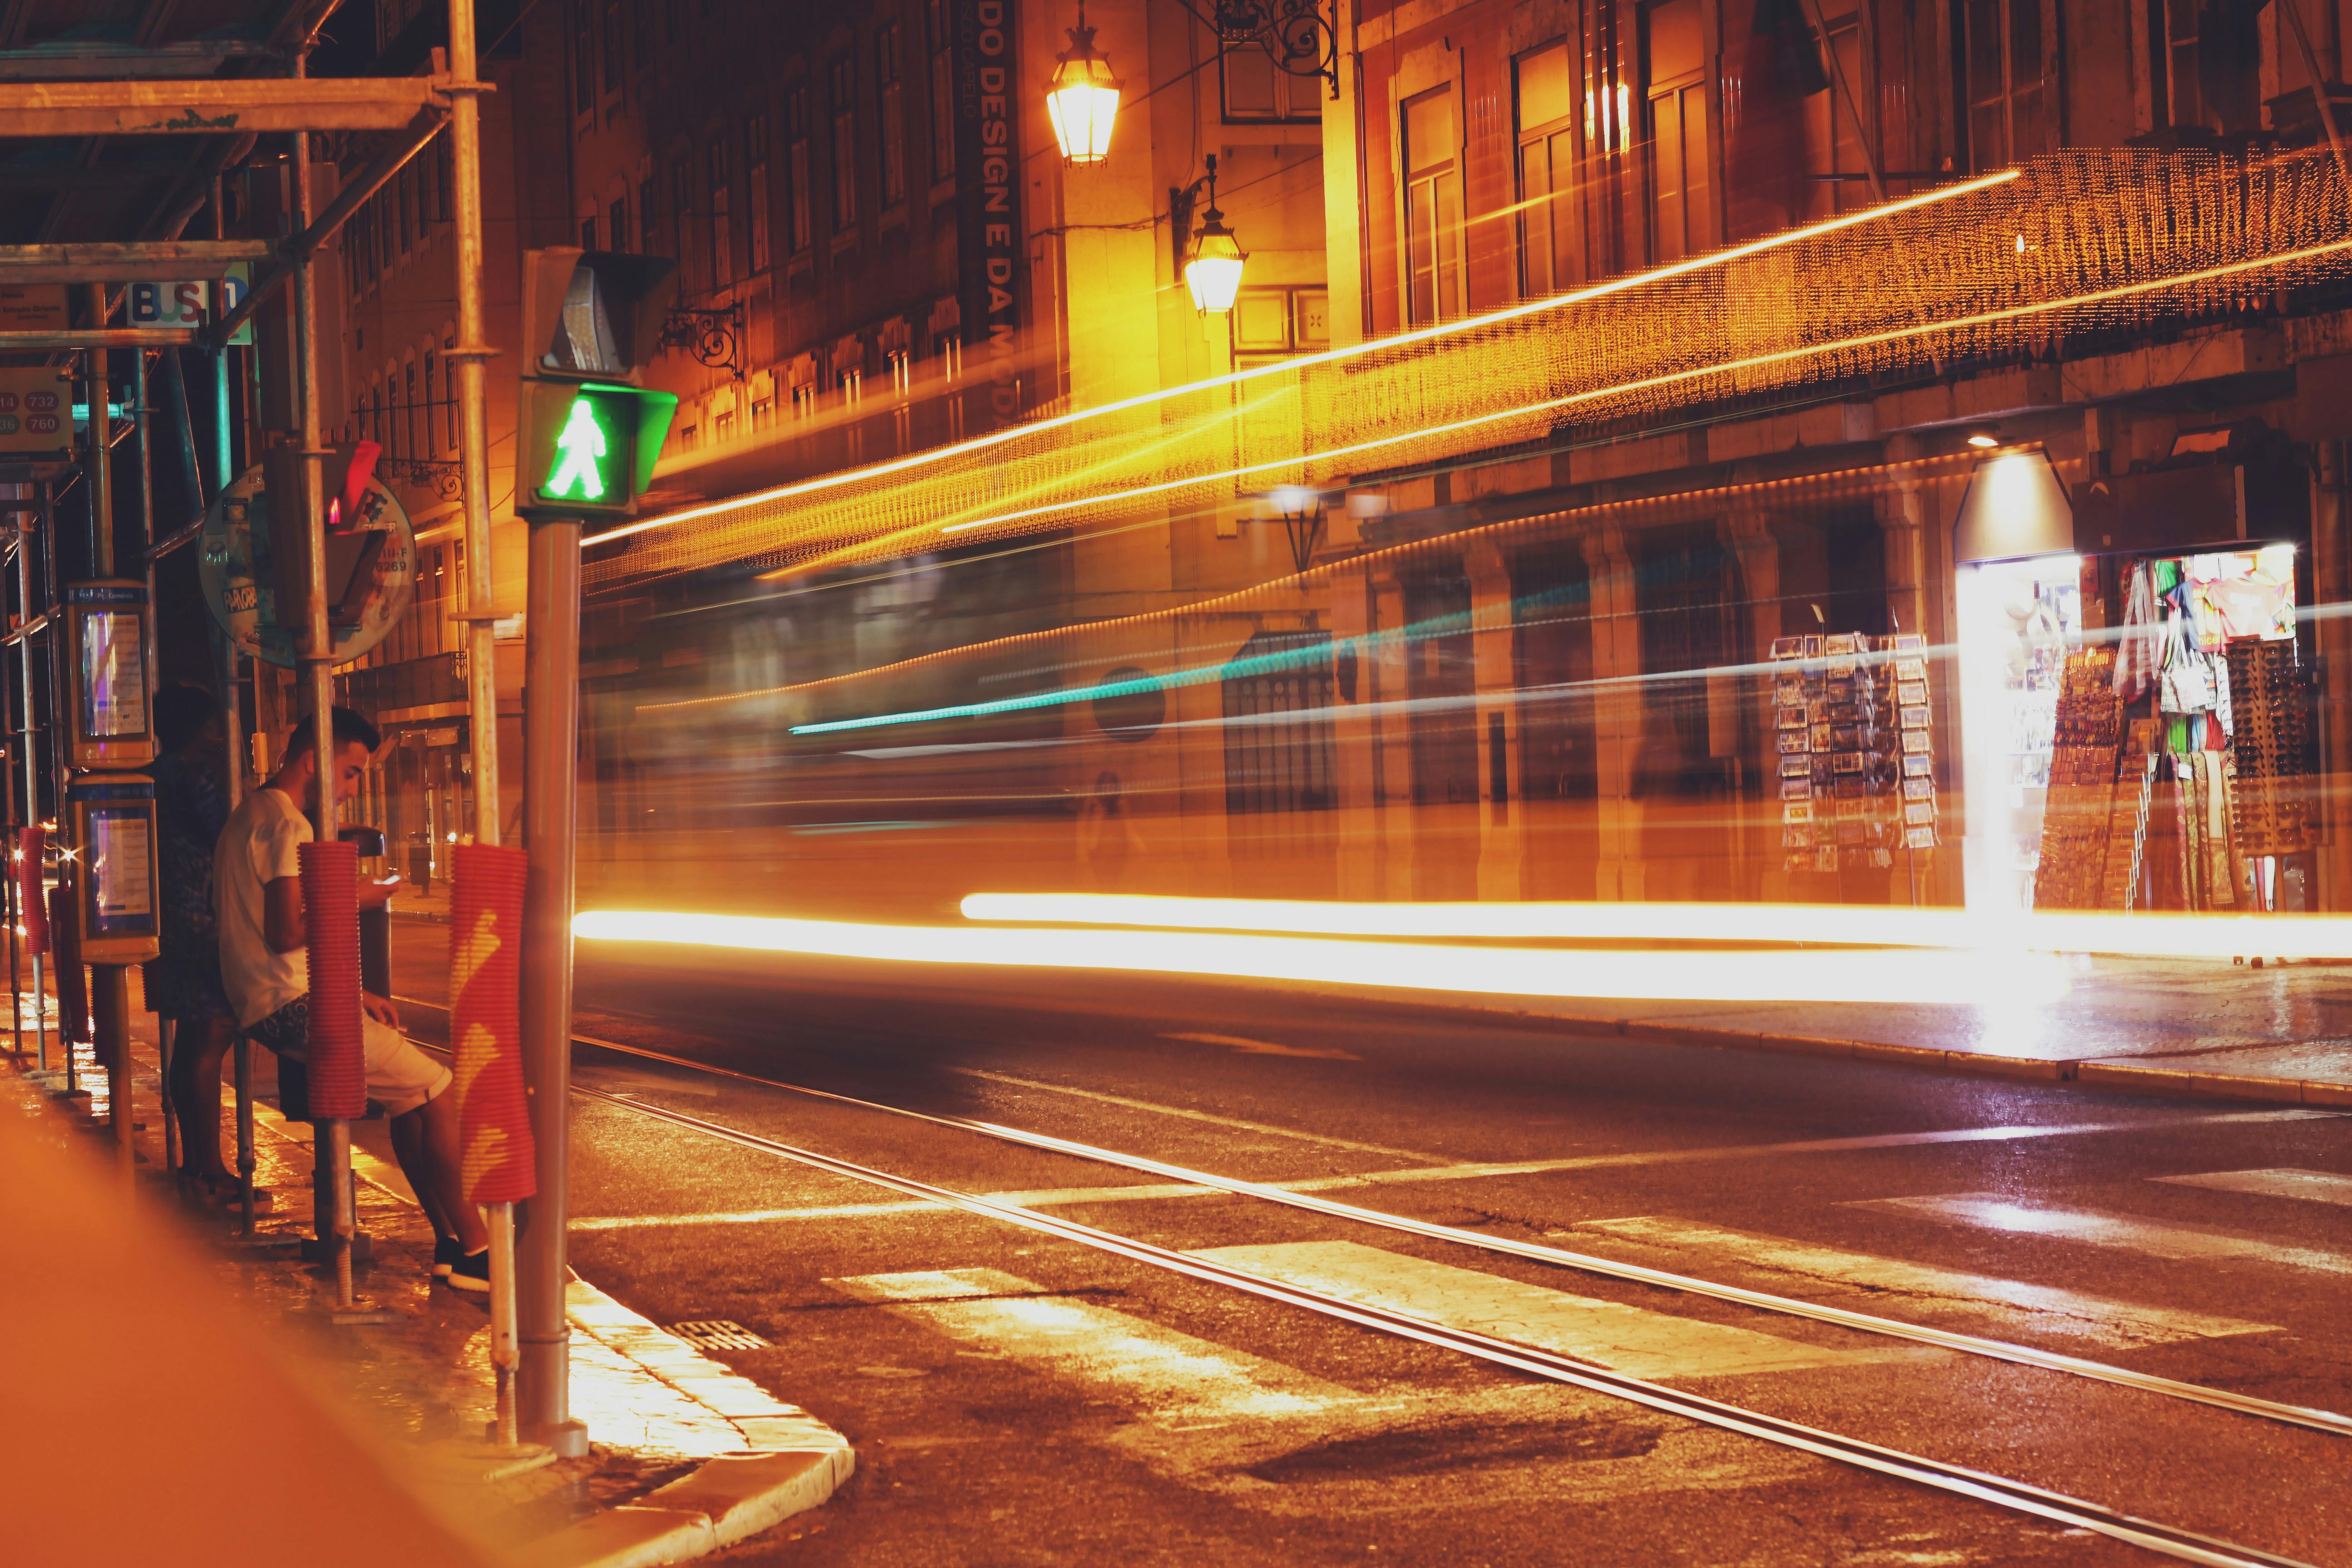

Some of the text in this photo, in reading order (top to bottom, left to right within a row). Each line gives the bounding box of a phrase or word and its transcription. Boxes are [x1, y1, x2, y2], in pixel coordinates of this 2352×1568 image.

[979, 0, 1004, 55] DO
[961, 47, 976, 119] CAPELO
[980, 67, 1009, 212] DESIGN
[985, 224, 1010, 247] E
[987, 258, 1012, 314] DA
[3, 305, 31, 314] Estação
[132, 283, 202, 323] BUS
[29, 396, 54, 407] 732
[30, 418, 55, 430] 760
[376, 561, 407, 573] 6269
